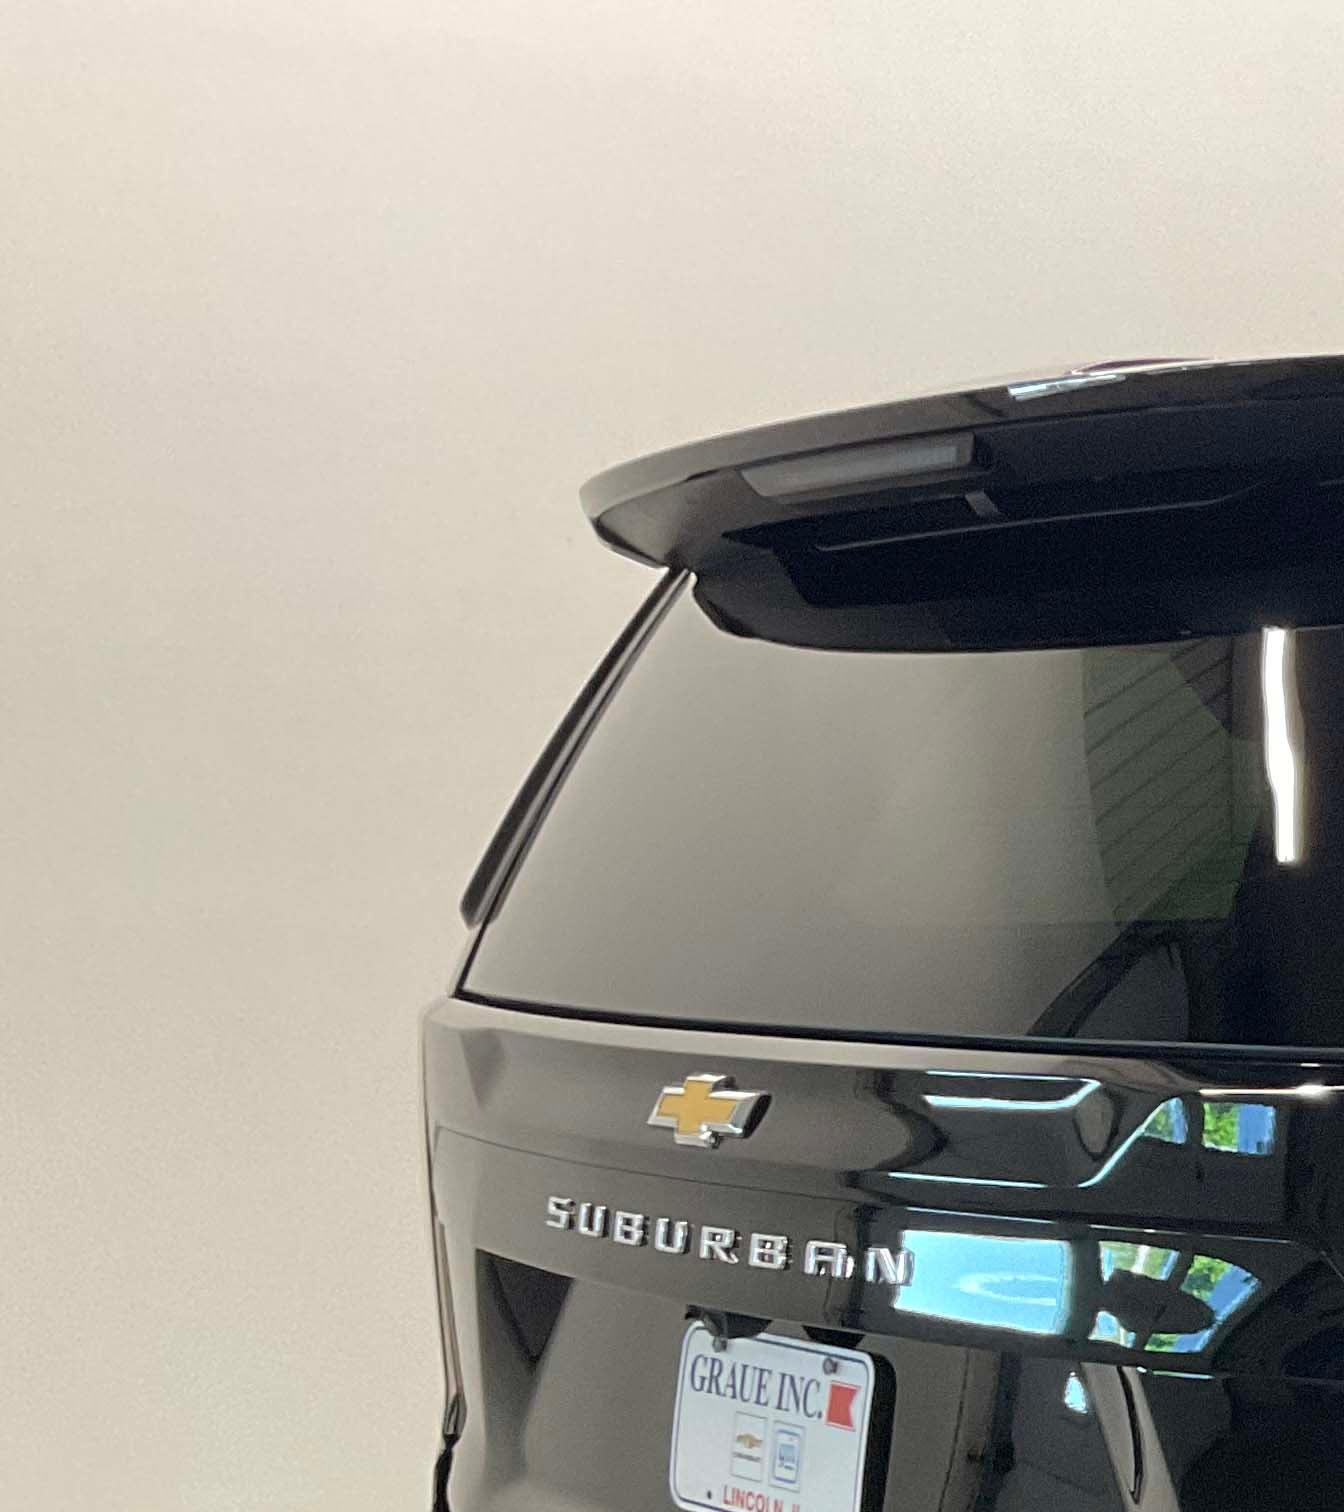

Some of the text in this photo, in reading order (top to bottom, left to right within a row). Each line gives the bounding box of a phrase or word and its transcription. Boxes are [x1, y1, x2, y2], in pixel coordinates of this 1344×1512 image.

[545, 1195, 915, 1287] SUBURBAN
[689, 1353, 823, 1420] GRAUE INC.
